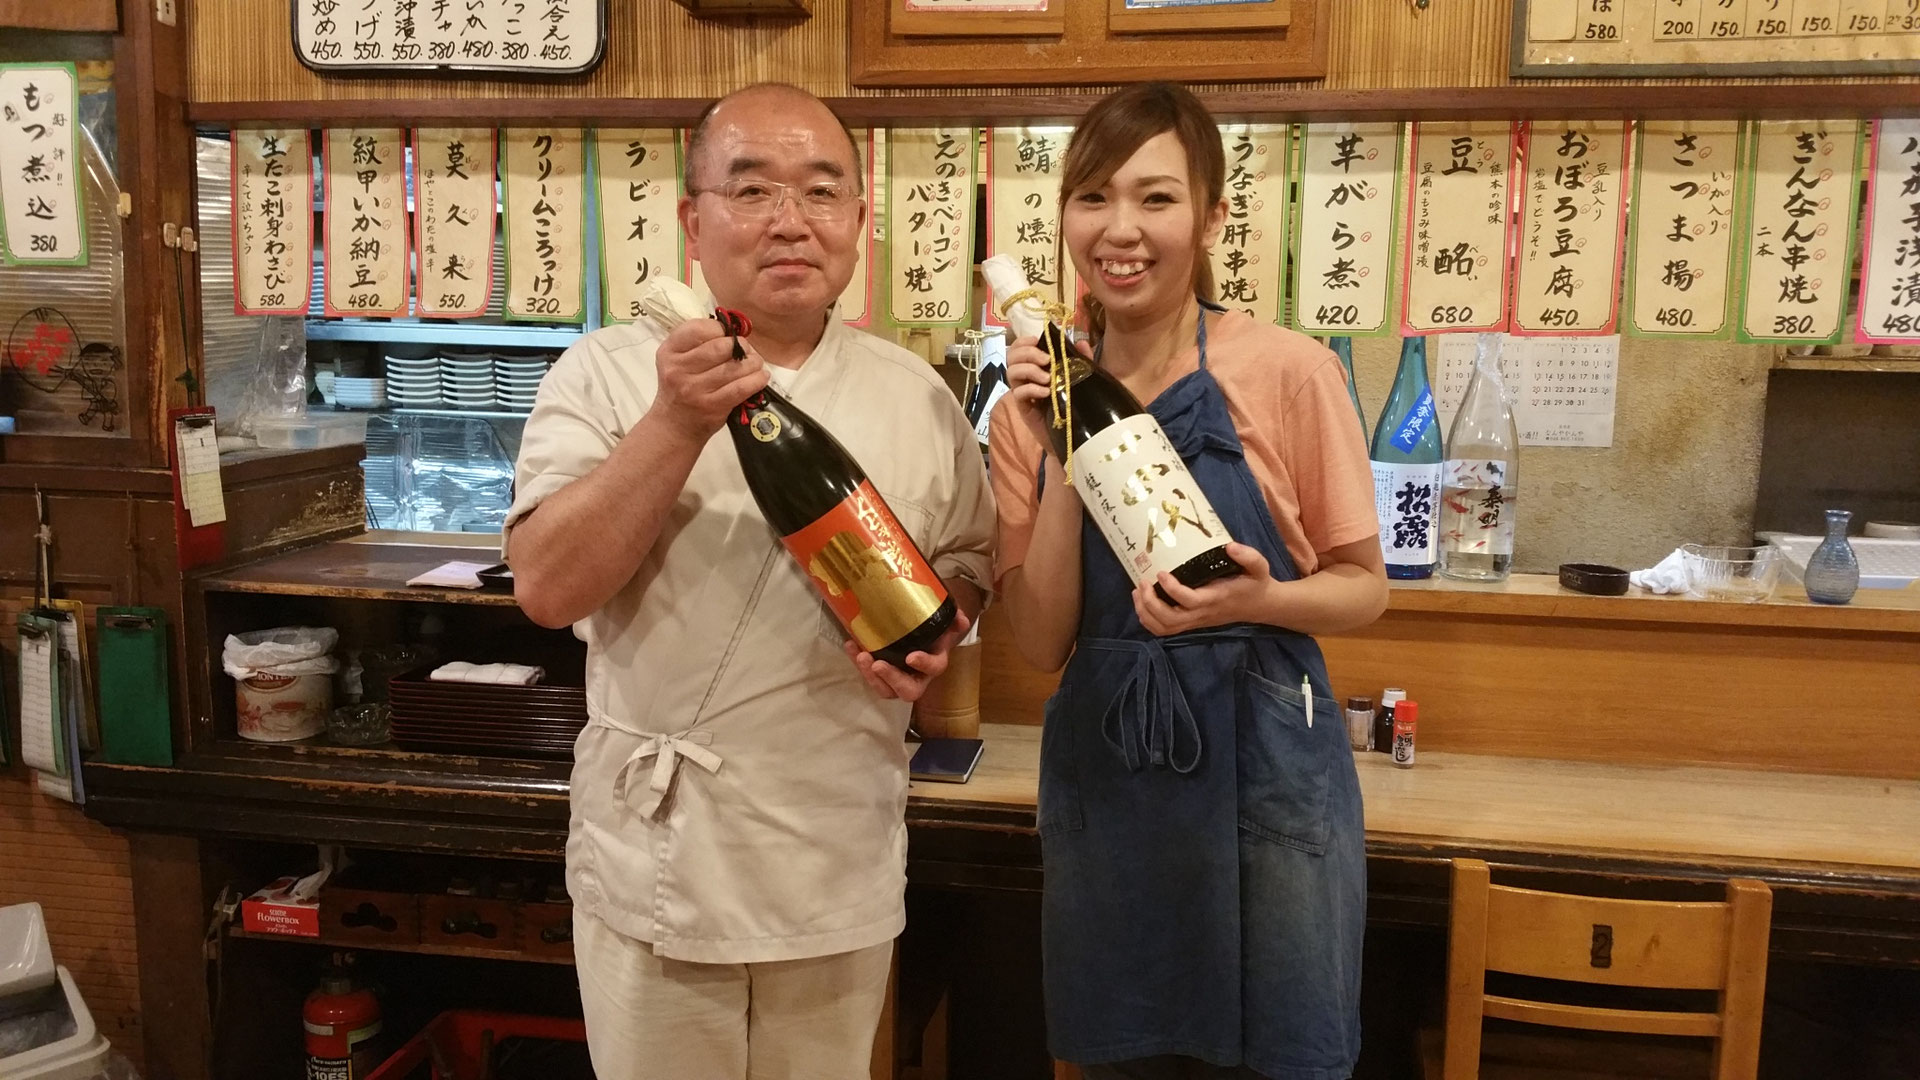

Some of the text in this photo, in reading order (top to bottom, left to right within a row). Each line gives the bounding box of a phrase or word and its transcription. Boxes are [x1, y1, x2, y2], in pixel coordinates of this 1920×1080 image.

[22, 82, 57, 220] もつ煮込
[259, 135, 287, 290] 生たこ刺身わさび
[349, 135, 383, 288] 紋甲いか納豆
[442, 140, 472, 280] 莫久来
[532, 135, 557, 296] クリームころっけ
[625, 141, 651, 284] ラビオリ
[932, 134, 960, 273] えのきベーコン
[1219, 135, 1259, 303] うなぎ肝串焼
[1322, 132, 1368, 291] 芋がら煮
[1433, 136, 1479, 277] 豆酩
[1544, 129, 1590, 299] おぼろ豆腐
[1591, 162, 1611, 222] 豆乳入り
[1661, 132, 1700, 292] さつま揚
[1707, 170, 1725, 236] いか入り
[1778, 130, 1828, 305] ぎんなん串焼
[904, 183, 935, 293] バター焼
[1755, 226, 1775, 257] 二本
